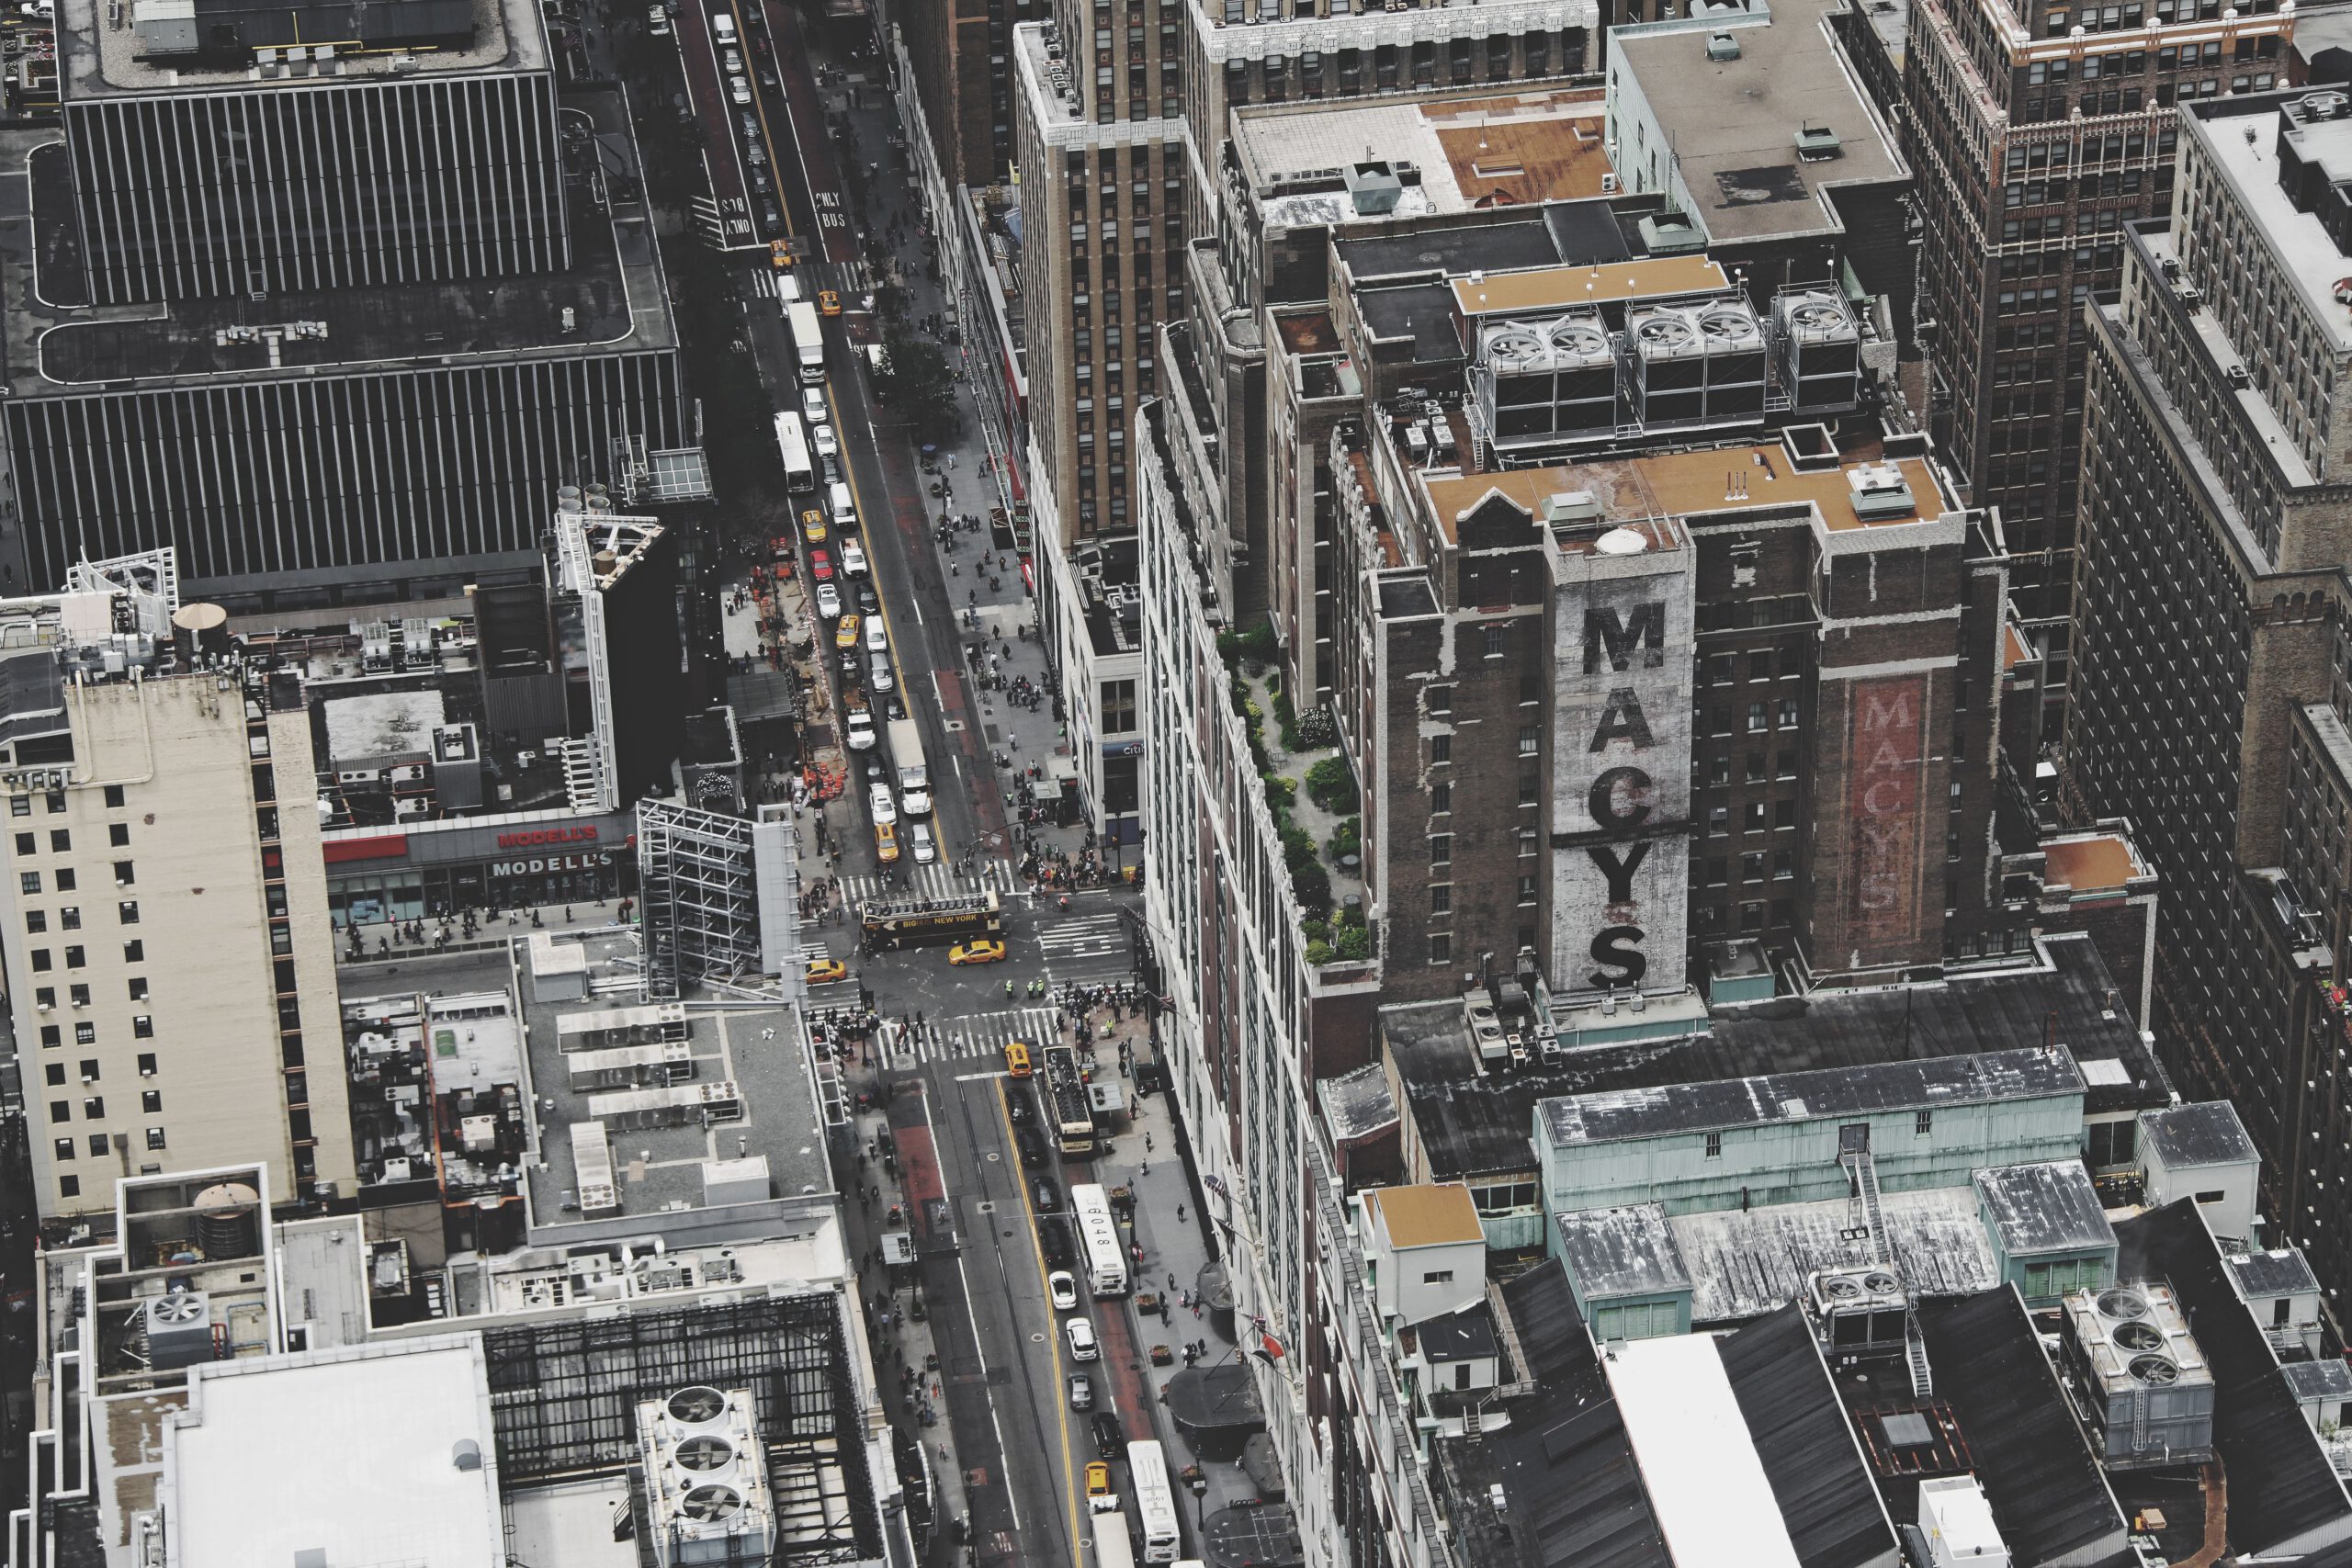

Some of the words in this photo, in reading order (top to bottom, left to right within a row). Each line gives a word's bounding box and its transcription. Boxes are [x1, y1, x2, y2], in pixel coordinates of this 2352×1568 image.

[726, 219, 750, 235] ONLY
[822, 213, 845, 227] BUS
[498, 825, 598, 848] MODELL'S
[492, 853, 612, 876] MODELL'S
[934, 917, 954, 925] NEW
[956, 913, 977, 922] YORK
